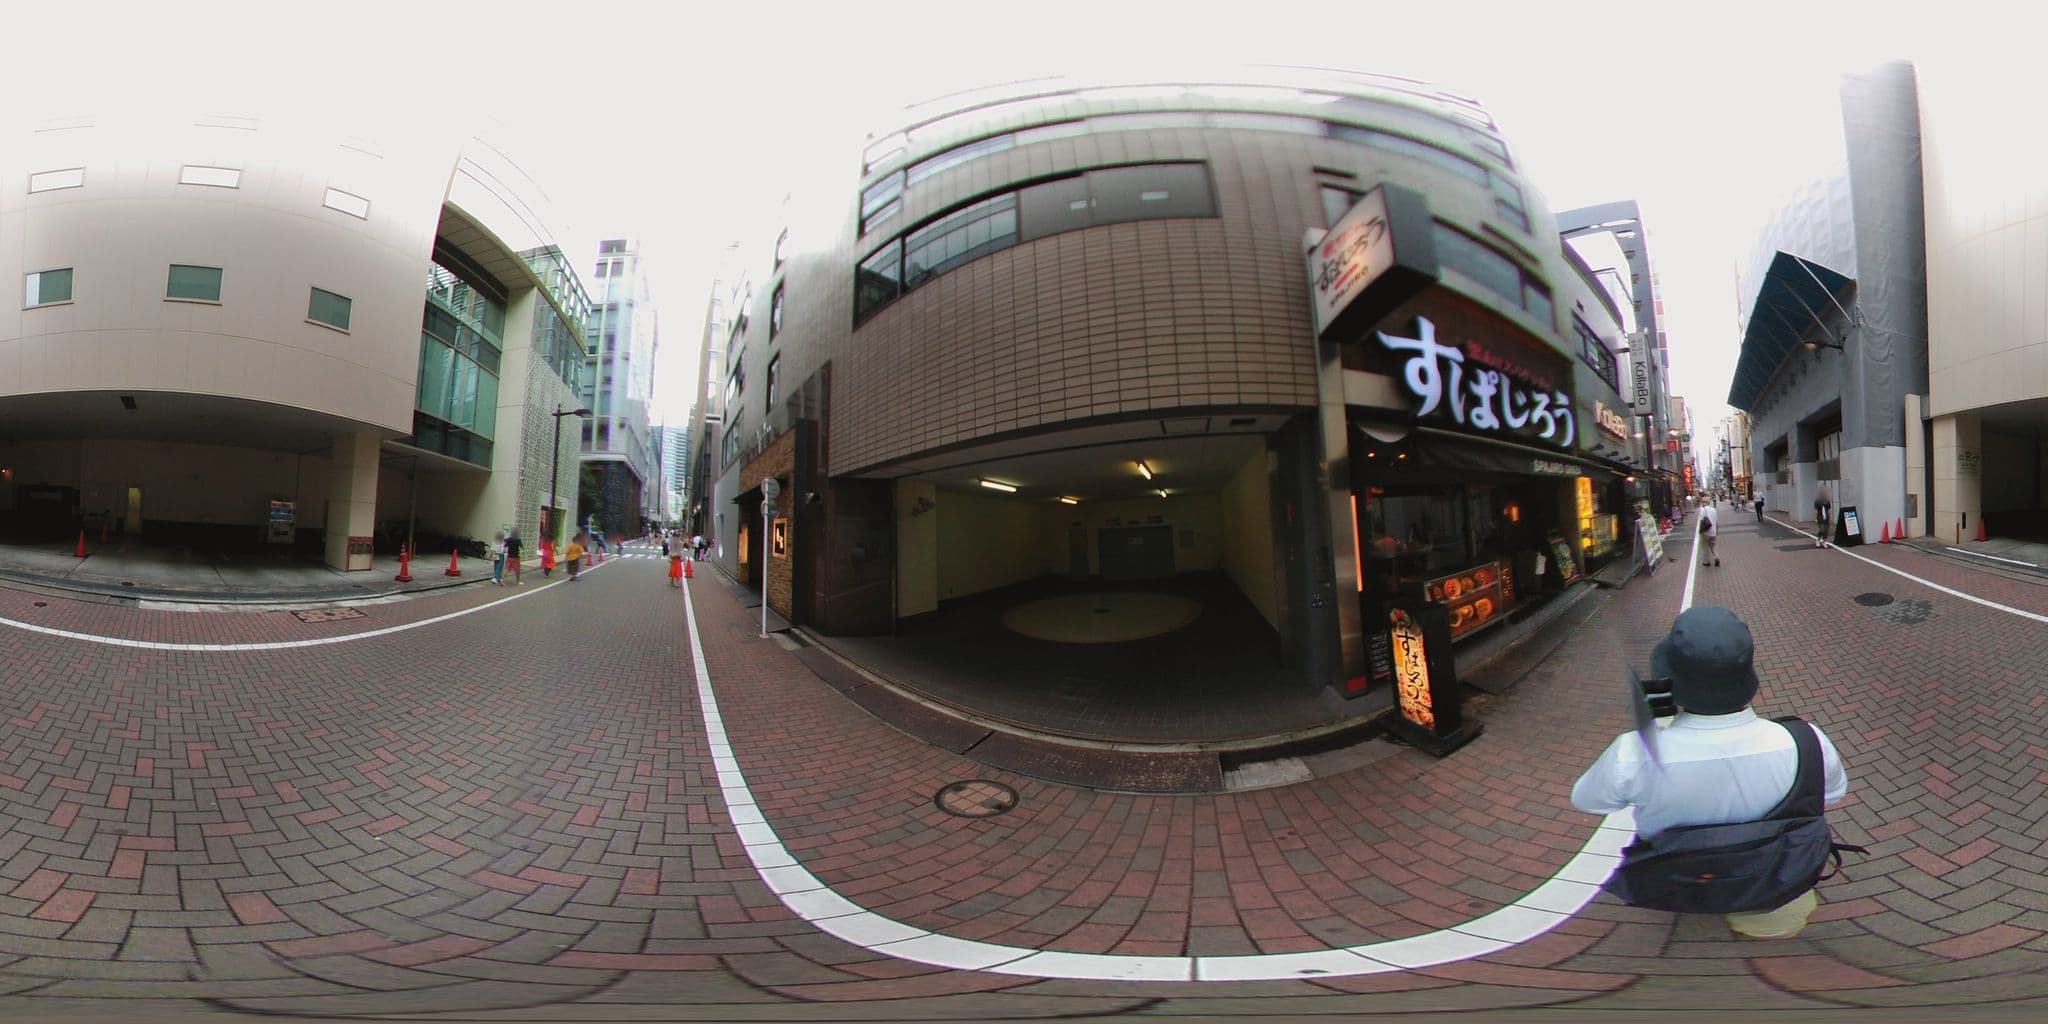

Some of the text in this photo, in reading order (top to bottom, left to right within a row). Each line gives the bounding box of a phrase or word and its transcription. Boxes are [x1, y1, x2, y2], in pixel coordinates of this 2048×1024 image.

[1315, 216, 1386, 291] すぱじろう
[1376, 315, 1575, 448] すぱじろう
[1633, 361, 1649, 406] KollaBo
